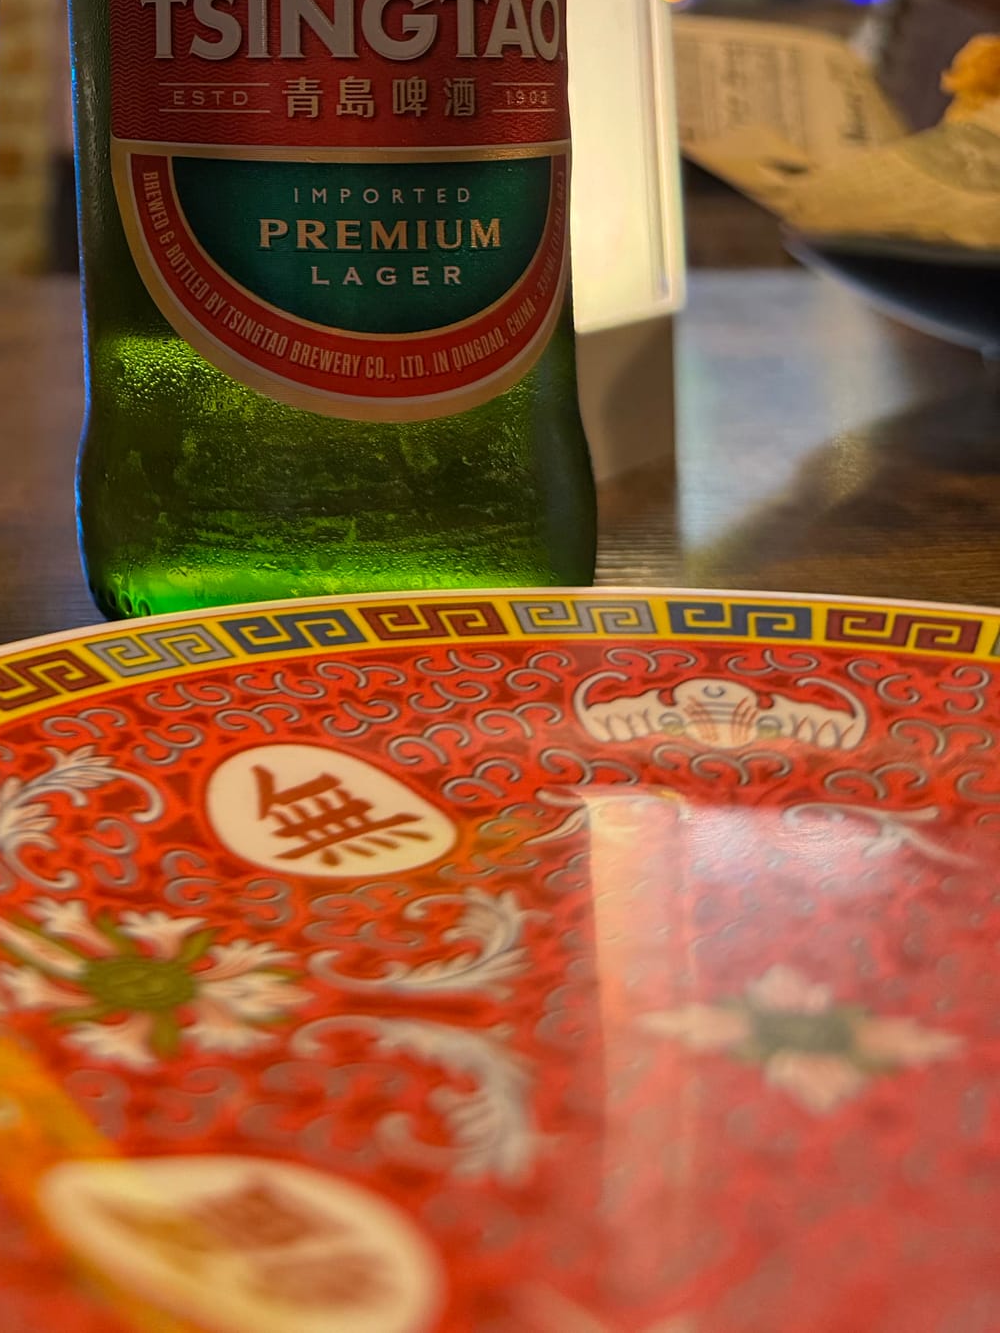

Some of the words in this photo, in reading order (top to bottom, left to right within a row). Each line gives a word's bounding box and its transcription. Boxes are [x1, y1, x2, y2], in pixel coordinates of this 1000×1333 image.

[172, 90, 250, 107] ESTD
[282, 74, 477, 118] 青島啤酒
[504, 90, 549, 106] 1903
[142, 170, 170, 230] BREWED
[293, 186, 472, 204] IMPORTED
[160, 230, 175, 244] &
[259, 217, 502, 250] PREMIUM
[165, 242, 210, 300] BOTTLED
[310, 265, 464, 286] LAGER
[204, 291, 227, 317] BY
[506, 297, 537, 336] CHINA
[222, 305, 289, 357] TSINGTAO
[289, 341, 362, 378] BREWERY
[401, 355, 430, 379] LTD.
[433, 351, 450, 374] IN
